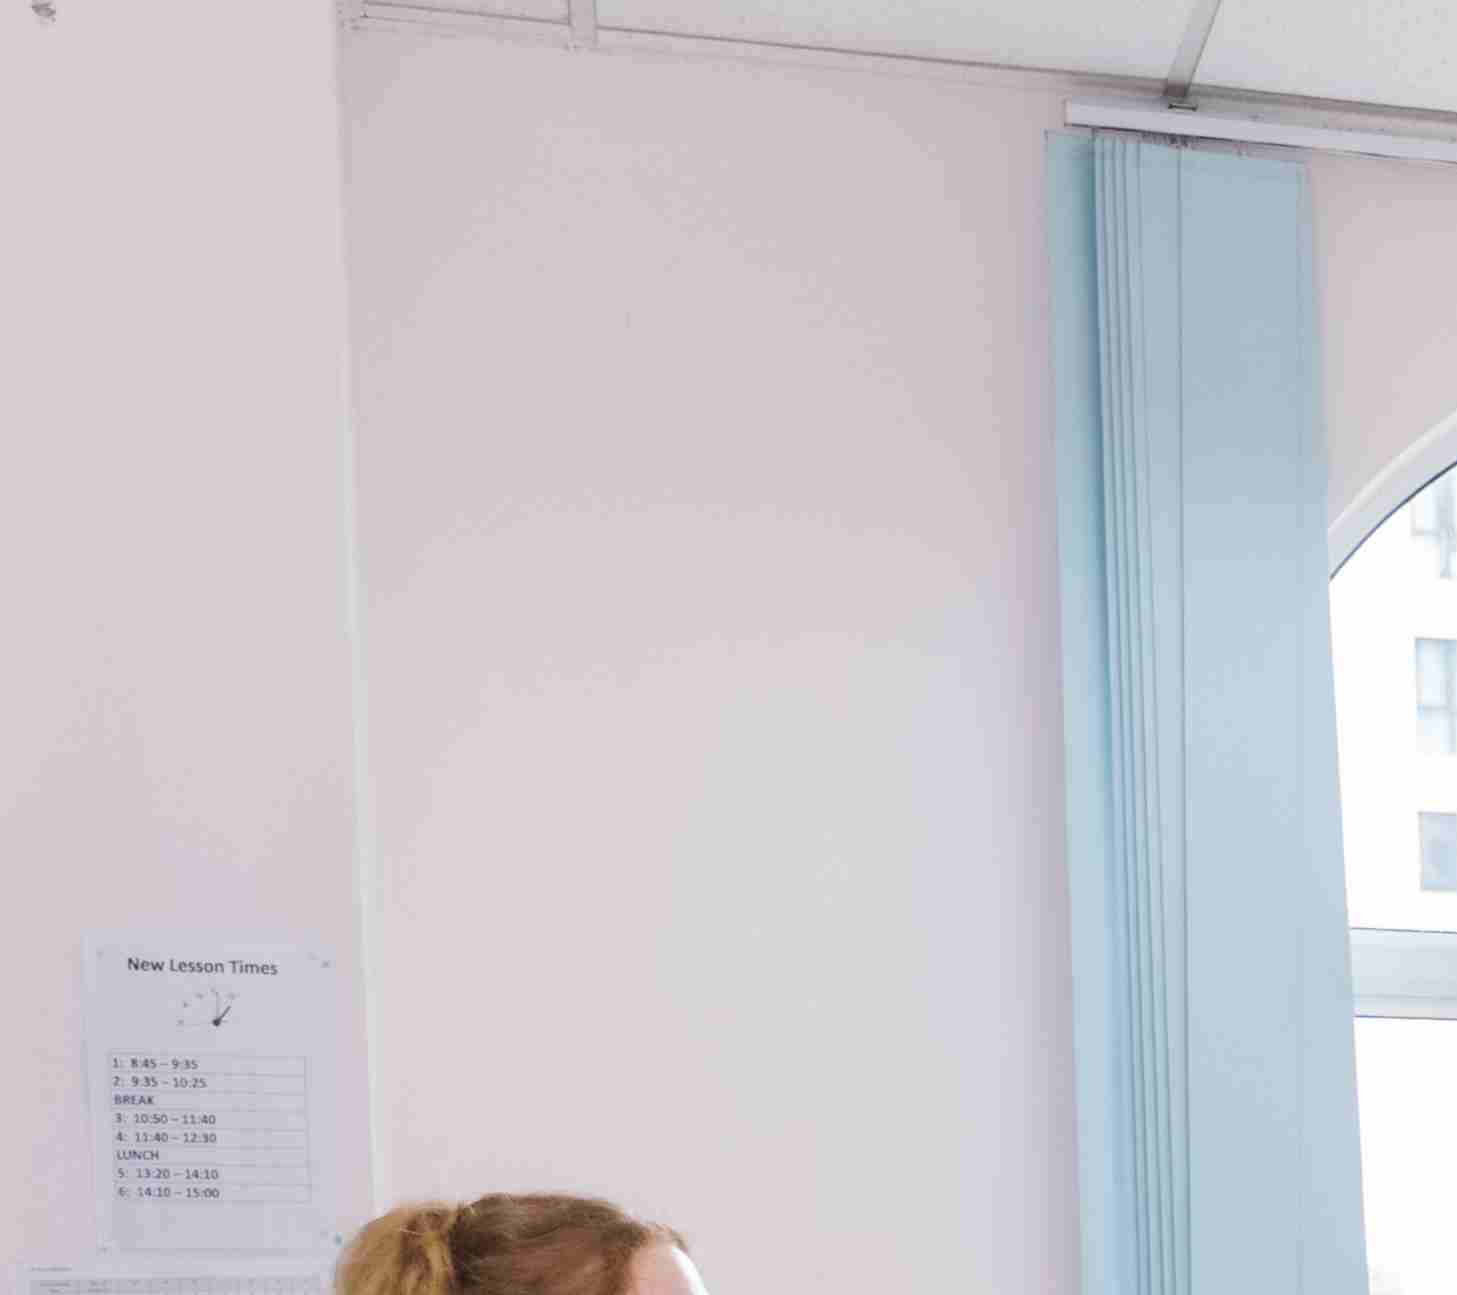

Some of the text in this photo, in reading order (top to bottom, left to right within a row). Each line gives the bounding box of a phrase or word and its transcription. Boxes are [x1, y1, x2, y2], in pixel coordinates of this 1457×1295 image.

[127, 957, 279, 976] New Lesson Times
[130, 1058, 157, 1069] 8:45
[171, 1059, 199, 1069] 9:35
[131, 1076, 159, 1088] 9:35
[173, 1077, 208, 1088] 10:25
[114, 1094, 154, 1105] BREAK
[135, 1113, 168, 1124] 10:50
[182, 1114, 216, 1125] 11:40
[135, 1132, 168, 1143] 11:40
[183, 1133, 217, 1143] 12:30
[116, 1150, 160, 1160] LUNCH
[136, 1168, 170, 1179] 13:20
[185, 1169, 219, 1180] 14:10
[137, 1188, 171, 1198] 14:10
[185, 1188, 220, 1199] 15:00
